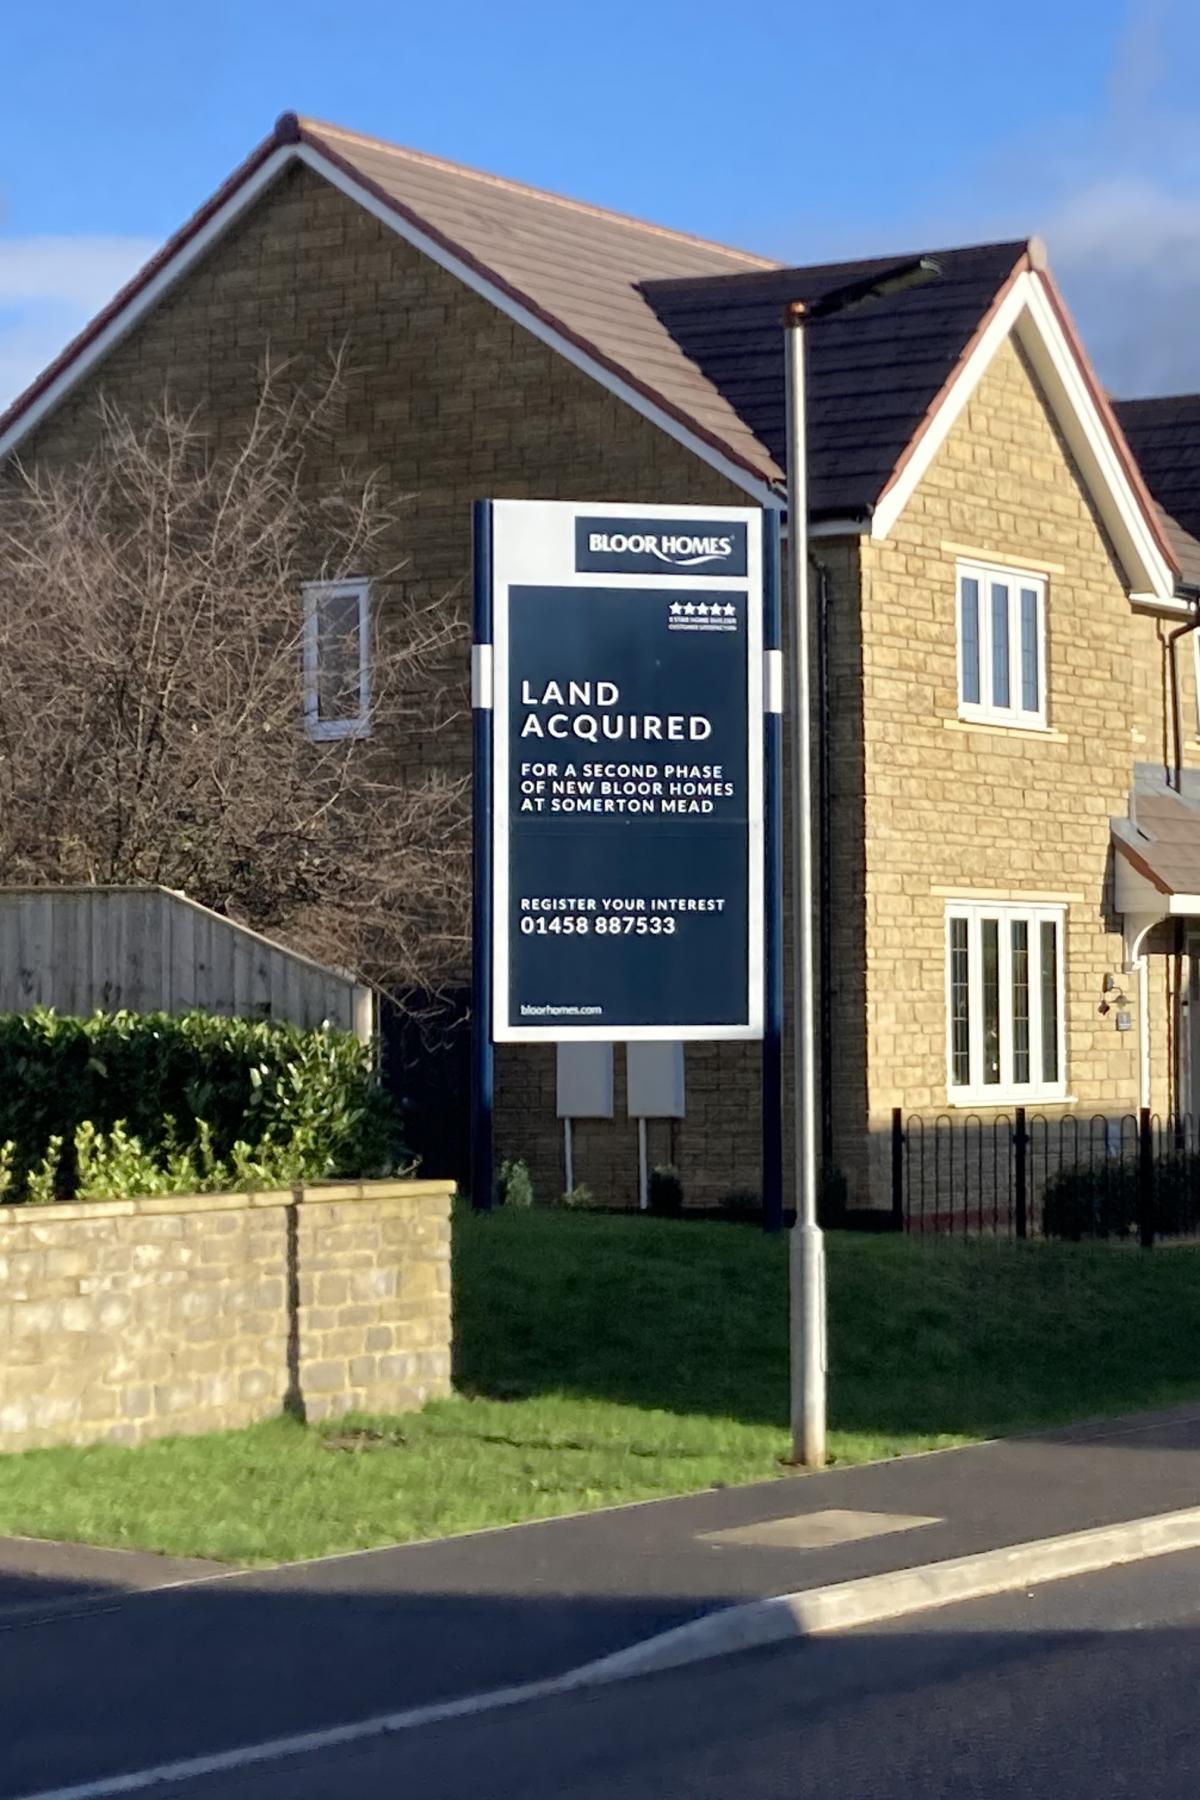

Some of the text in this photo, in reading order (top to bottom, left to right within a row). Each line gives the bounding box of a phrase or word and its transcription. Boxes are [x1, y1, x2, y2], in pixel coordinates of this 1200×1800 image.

[589, 533, 732, 556] BLOOR HOMES
[520, 680, 620, 707] LAND
[520, 713, 712, 743] ACQUIRED
[520, 762, 723, 780] FOR A SECOND PHASE
[520, 780, 734, 797] OF NEW BLOOR HOMES
[520, 798, 714, 814] AT SOMERTON MEAD
[520, 898, 726, 912] REGISTER YOUR INTEREST
[520, 916, 676, 935] 01458 887533
[520, 1004, 603, 1016] bloorhomes.com
